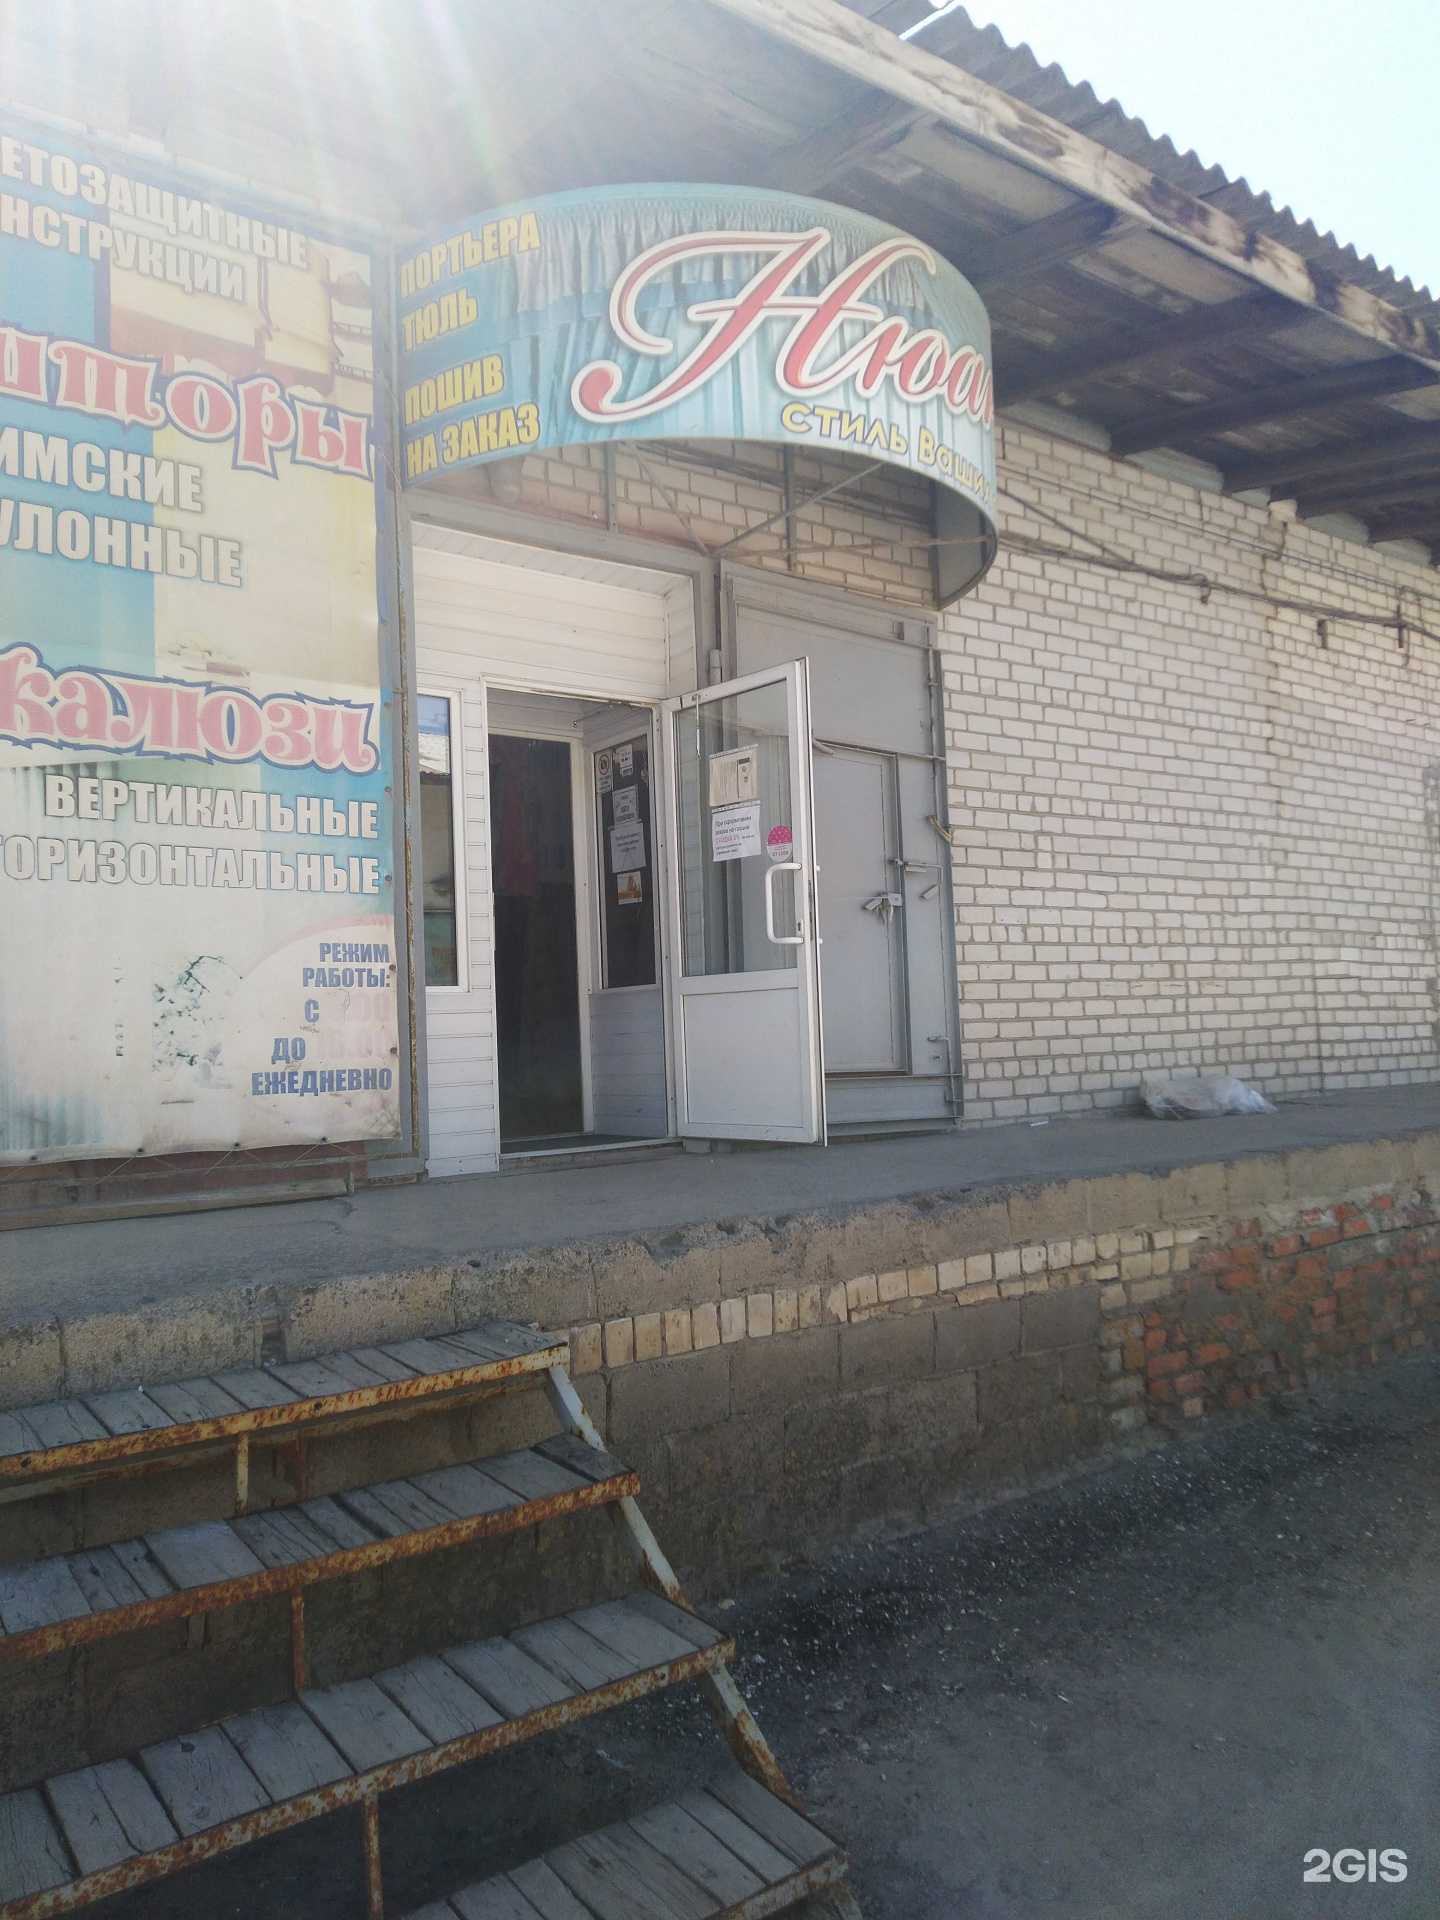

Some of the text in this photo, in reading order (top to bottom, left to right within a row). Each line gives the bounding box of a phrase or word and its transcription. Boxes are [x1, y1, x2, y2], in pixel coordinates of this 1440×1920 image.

[0, 136, 309, 271] ЕТОЗАЩИТНЫЕ
[0, 194, 243, 302] НСТРУКЦИИ
[400, 212, 540, 298] ПОРТЬЕРА
[402, 288, 477, 352] ТЮЛЬ
[404, 354, 504, 425] ПОШИВ
[406, 403, 540, 481] НА ЗАКАЗ
[44, 774, 379, 839] ВЕРТИКАЛЬНЫЕ
[0, 834, 380, 894] ОРИЗОНТАЛЬНЫЕ
[302, 967, 390, 988] РАБОТЫ:
[319, 942, 389, 963] РЕЖИМ
[304, 998, 320, 1023] С
[251, 1067, 393, 1097] ЕЖЕДНЕВНО
[271, 1037, 306, 1065] ДО
